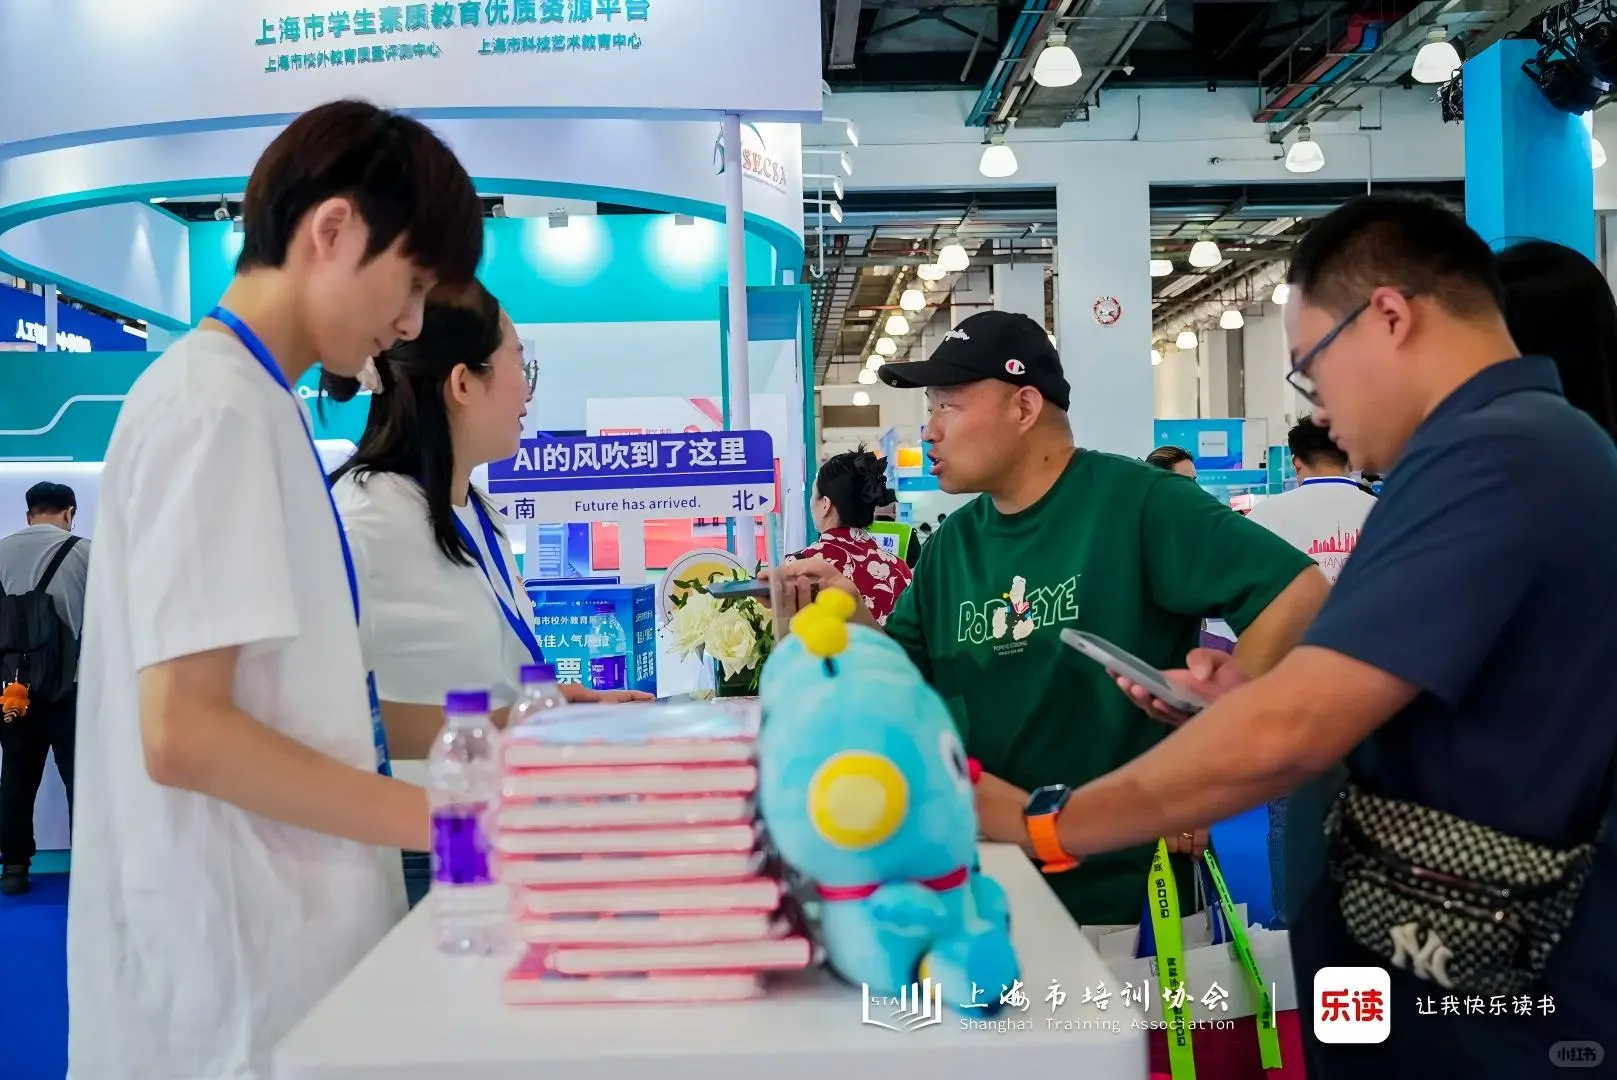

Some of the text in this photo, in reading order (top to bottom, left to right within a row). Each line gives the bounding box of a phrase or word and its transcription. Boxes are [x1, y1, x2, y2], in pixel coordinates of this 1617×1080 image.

[255, 0, 651, 46] 上海市学生素质教育优质资源平台
[477, 32, 642, 56] 上海市科技艺术教育中心
[513, 436, 748, 472] AI的风吹到了这里
[514, 489, 755, 520] 南 Future has arrived. 北
